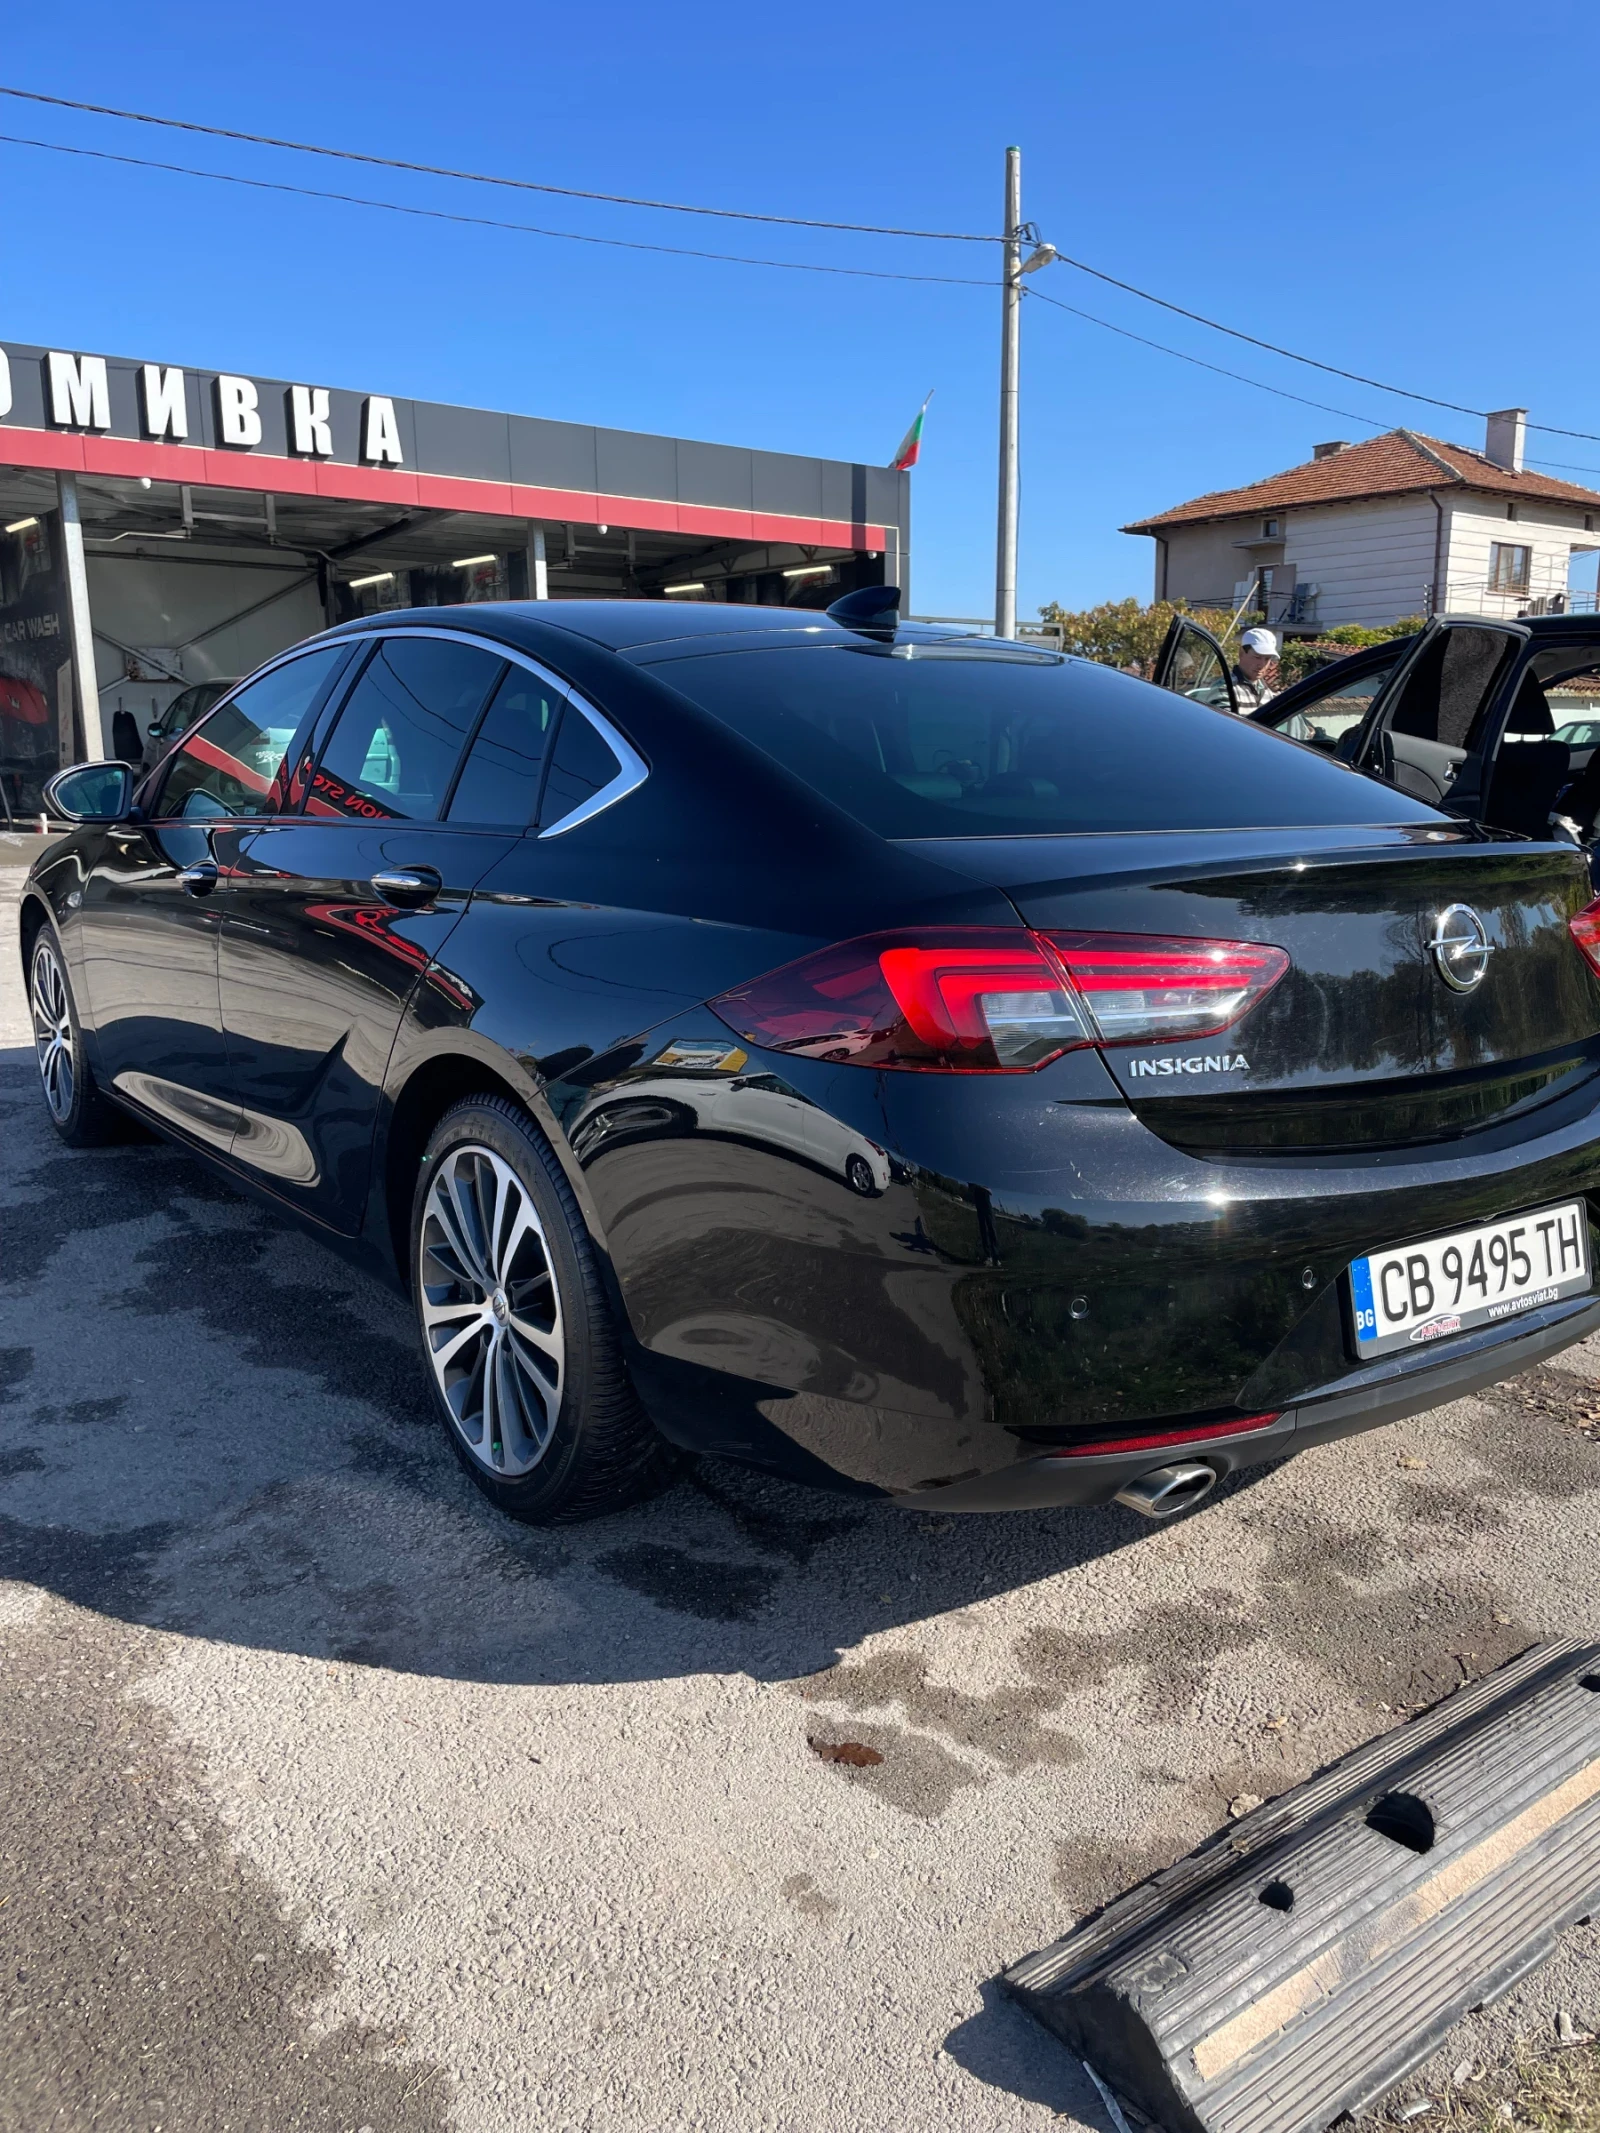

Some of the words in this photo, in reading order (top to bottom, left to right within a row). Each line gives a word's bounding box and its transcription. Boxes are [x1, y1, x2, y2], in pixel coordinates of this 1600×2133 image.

[0, 346, 403, 463] МИВКА
[4, 620, 26, 643] CAR
[27, 613, 60, 640] WASH
[1129, 1054, 1250, 1077] INSIGNIA
[1381, 1253, 1435, 1322] CB
[1442, 1227, 1532, 1305] 9495
[1536, 1214, 1580, 1277] TH
[1487, 1288, 1558, 1318] www.avtosviat.bg
[1356, 1310, 1374, 1330] BG
